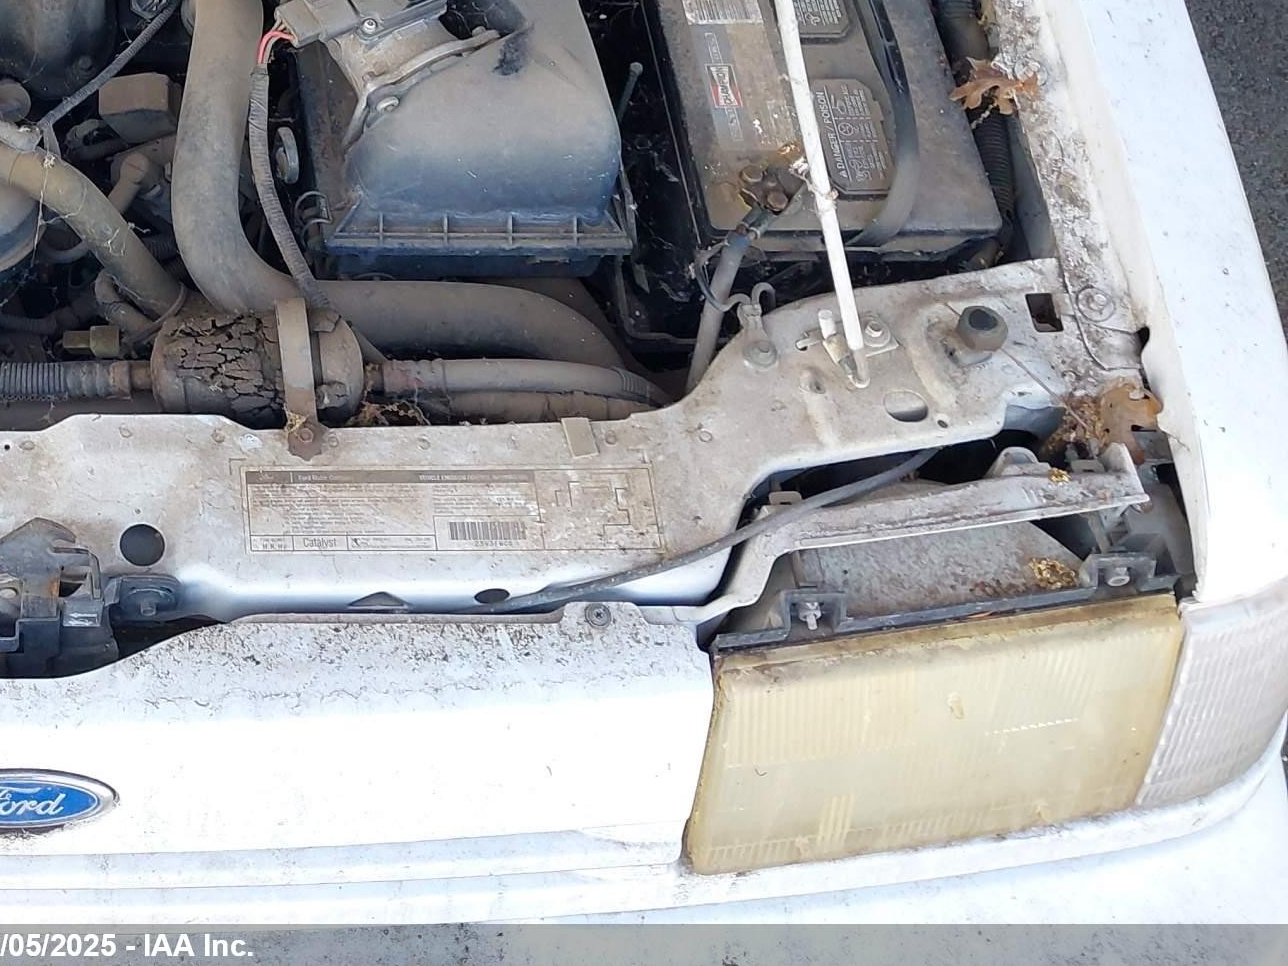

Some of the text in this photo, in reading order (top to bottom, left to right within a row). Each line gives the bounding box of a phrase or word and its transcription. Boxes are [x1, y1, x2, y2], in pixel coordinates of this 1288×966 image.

[713, 65, 733, 105] CHAMPION
[815, 91, 833, 124] POISON
[828, 132, 845, 170] DANGER
[302, 537, 338, 549] Catalyst
